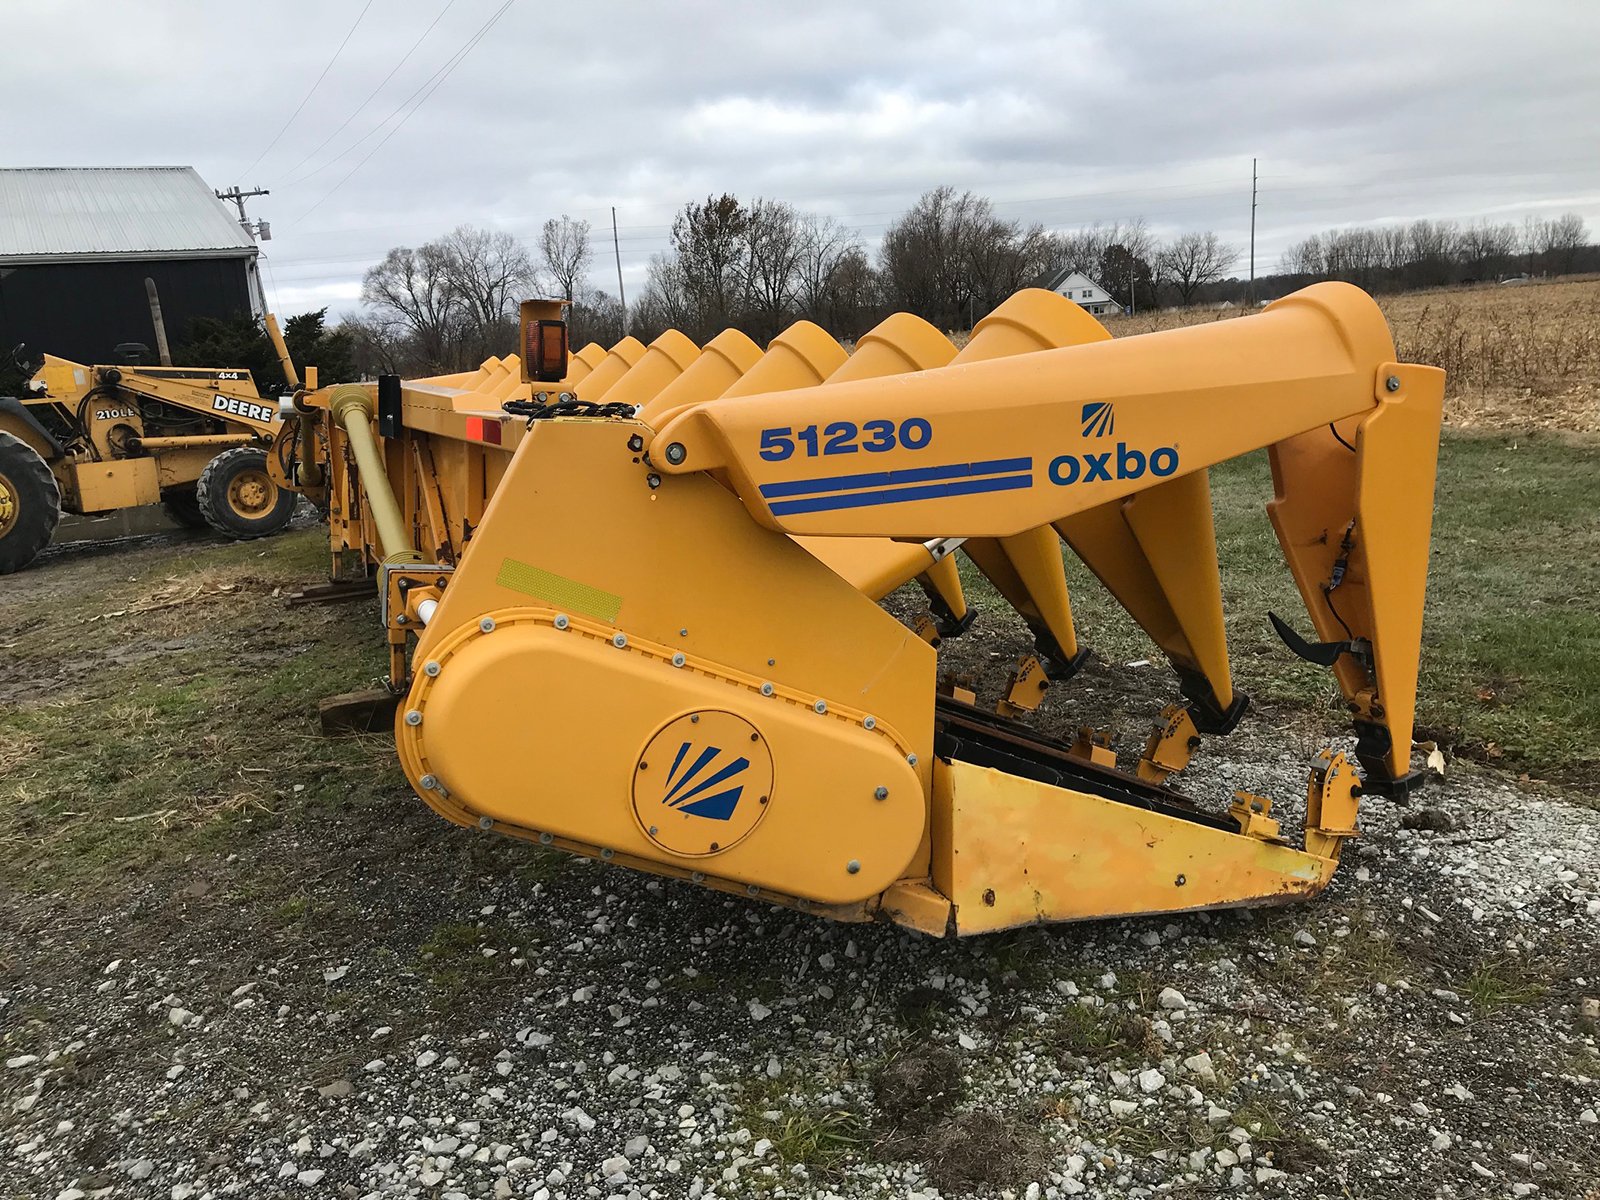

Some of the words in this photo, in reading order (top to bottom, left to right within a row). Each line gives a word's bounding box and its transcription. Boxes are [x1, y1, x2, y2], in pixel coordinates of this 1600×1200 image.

[218, 372, 239, 380] 4x4
[213, 394, 272, 422] DEERE
[759, 417, 933, 462] 51230
[1048, 442, 1179, 486] oxbo
